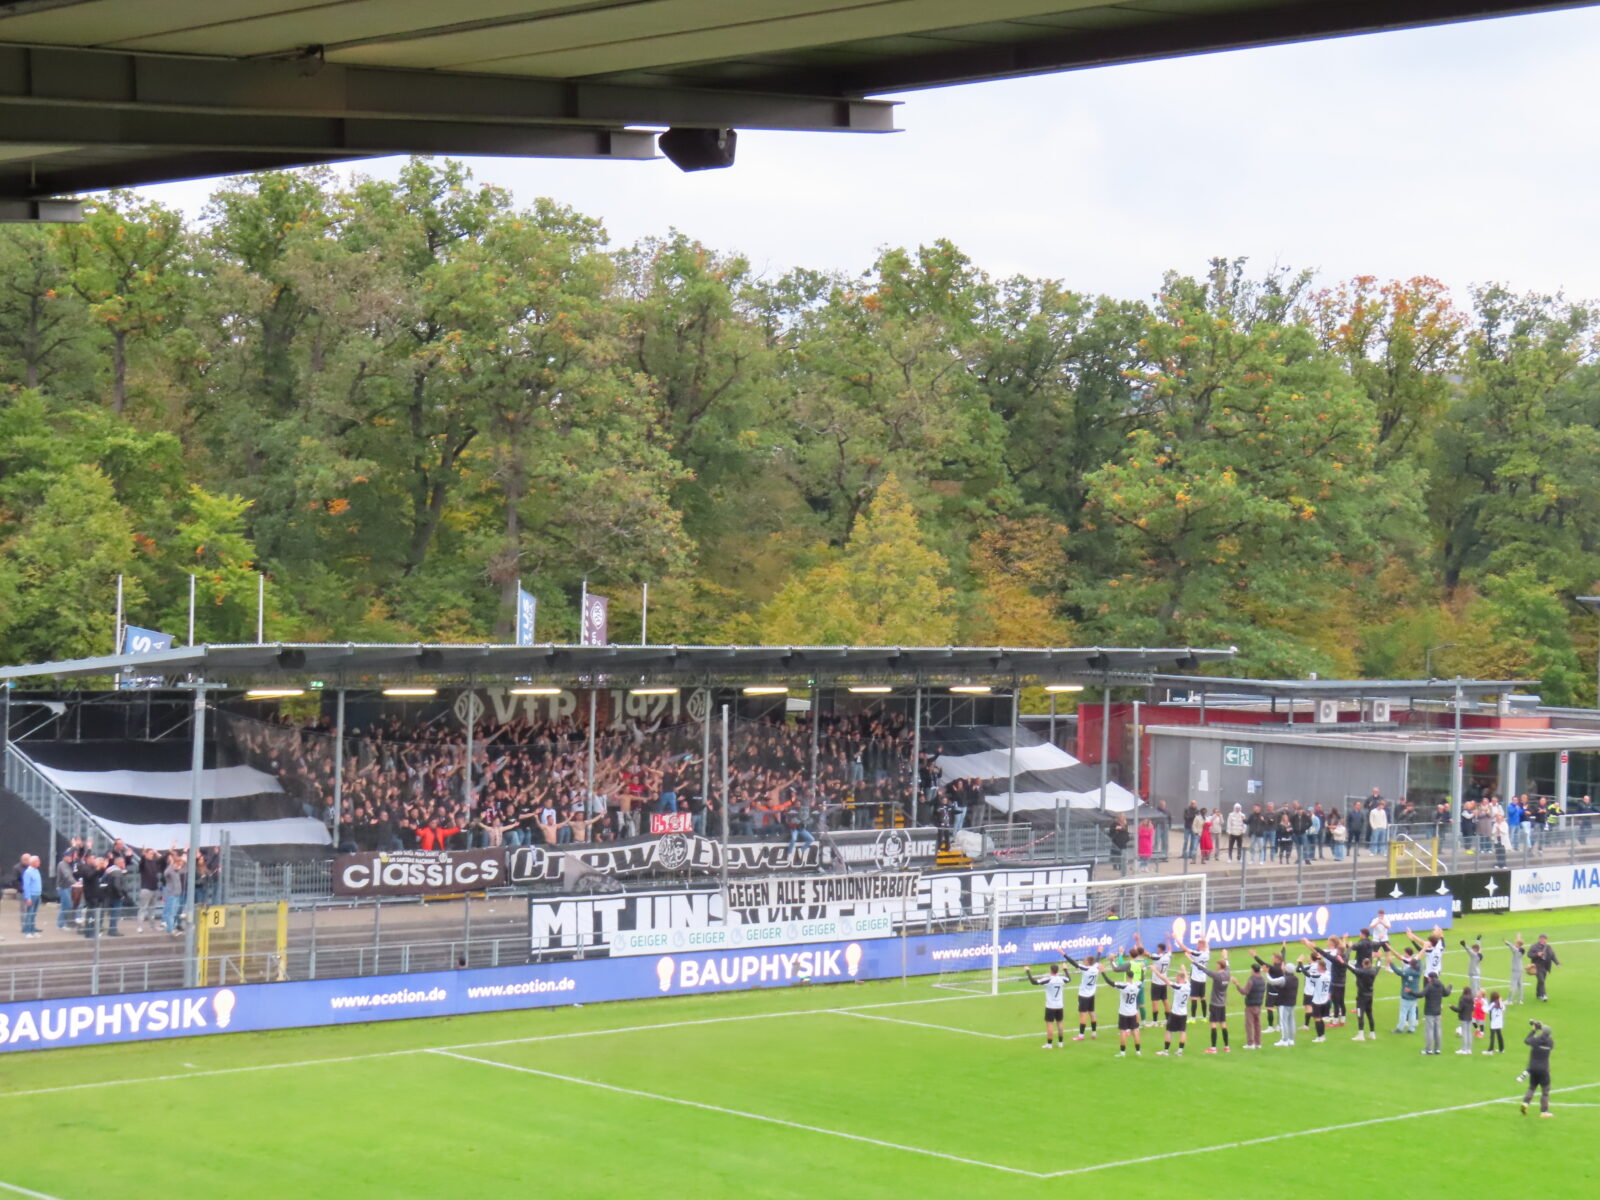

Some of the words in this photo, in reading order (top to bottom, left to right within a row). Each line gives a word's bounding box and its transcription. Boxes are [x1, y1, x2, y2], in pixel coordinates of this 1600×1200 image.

[904, 840, 936, 857] ELITE
[511, 842, 657, 881] Crew
[691, 835, 820, 870] Eleven
[342, 857, 499, 888] classics
[728, 883, 770, 908] GEGEN
[777, 880, 806, 905] ALLE
[812, 875, 918, 903] STADIONVERBOTE
[1518, 881, 1560, 895] MANGOLD
[532, 898, 626, 948] MIT
[971, 868, 1089, 915] MEHR
[746, 927, 781, 941] GEIGER
[801, 923, 836, 937] GEIGER
[856, 918, 888, 932] GEIGER
[1190, 911, 1313, 945] BAUPHYSIK
[630, 934, 667, 948] GEIGER
[689, 931, 725, 945] GEIGER
[1033, 934, 1112, 952] www.ecotion.de
[680, 949, 842, 987] BAUPHYSIK
[468, 977, 576, 999] www.ecotion.de
[1054, 985, 1061, 998] 7
[331, 987, 446, 1008] www.ecotion.de
